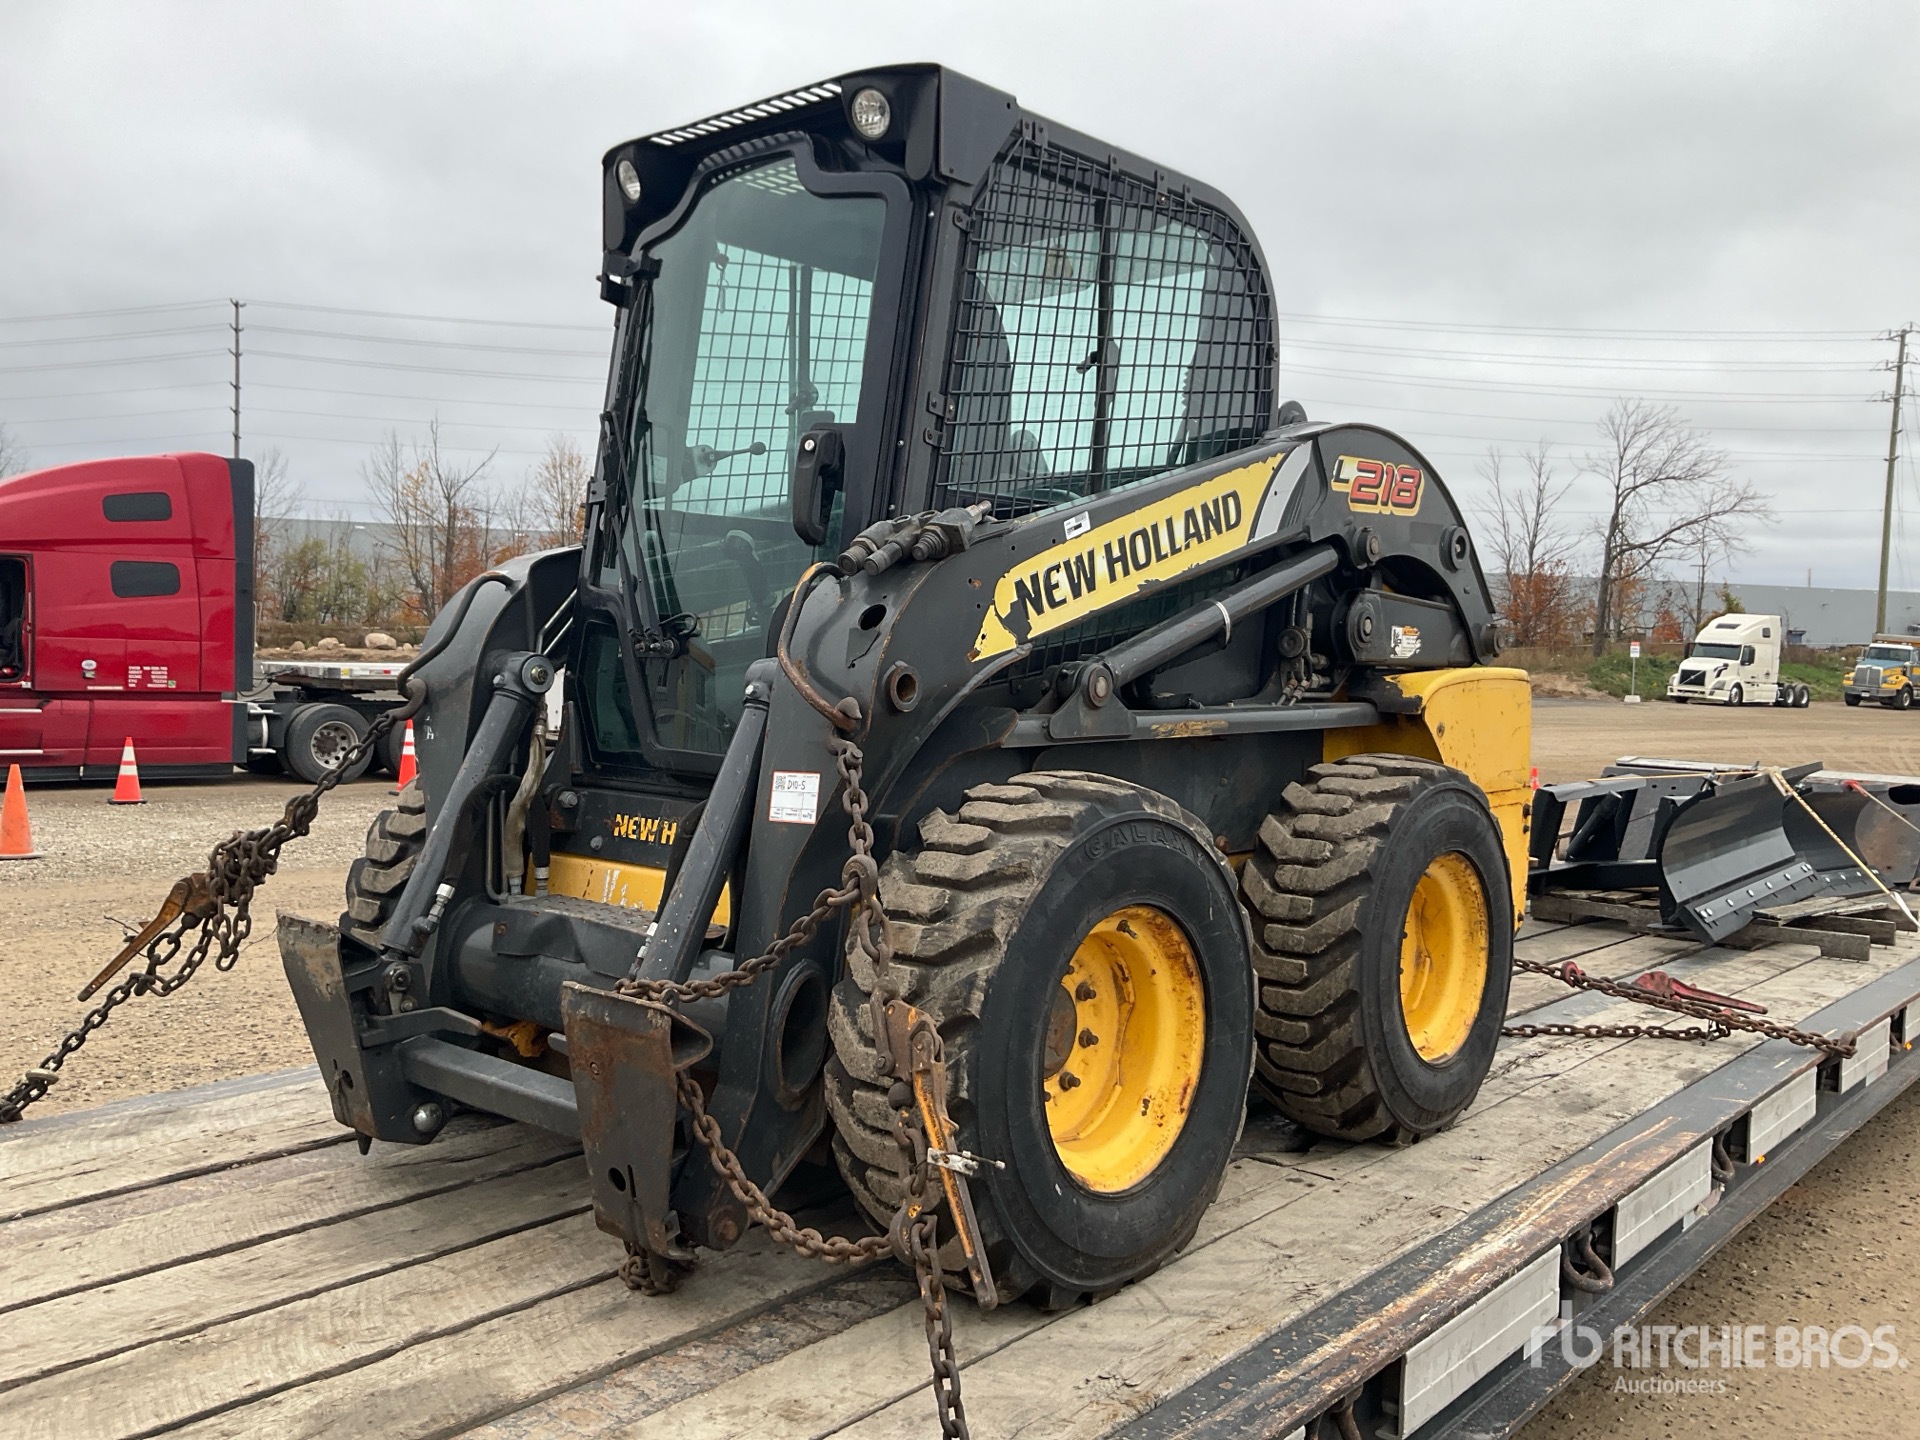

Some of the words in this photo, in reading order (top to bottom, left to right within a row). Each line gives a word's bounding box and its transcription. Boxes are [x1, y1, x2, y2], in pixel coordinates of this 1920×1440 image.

[1332, 456, 1423, 512] L218
[1014, 547, 1096, 616] NEW
[1103, 489, 1242, 583] HOLLAND
[613, 813, 660, 843] NEW
